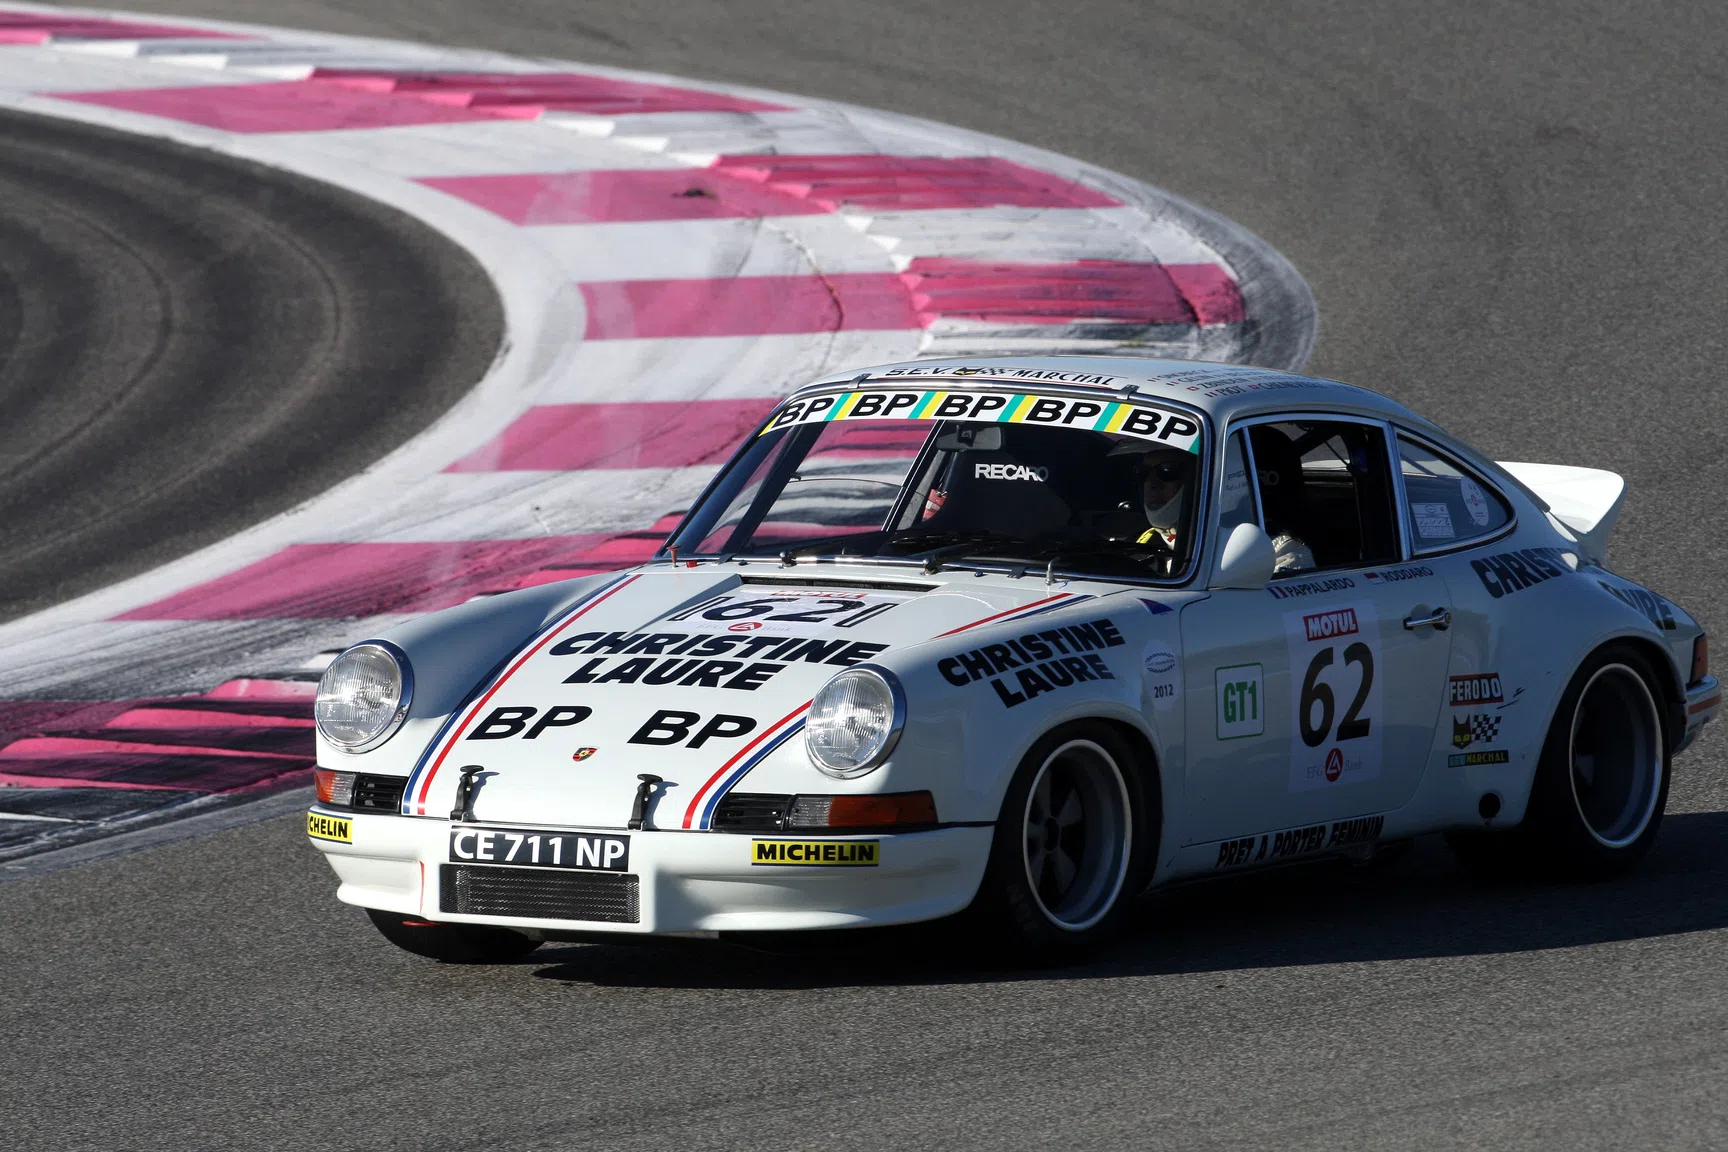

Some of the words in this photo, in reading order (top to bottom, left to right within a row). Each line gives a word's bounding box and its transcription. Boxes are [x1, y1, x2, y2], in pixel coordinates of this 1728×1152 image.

[1011, 369, 1115, 386] MARCHAL
[772, 397, 835, 428] BP
[848, 393, 919, 417] BP
[934, 394, 1007, 418] BP
[1025, 398, 1102, 425] BP
[1121, 408, 1198, 441] BP
[974, 463, 1049, 482] RECARO
[1284, 577, 1356, 597] PAPPALARDO
[702, 598, 866, 622] 62
[1306, 610, 1358, 639] MOTUL
[548, 631, 890, 667] CHRISTINE
[937, 618, 1126, 687] CHRISTINE
[561, 657, 788, 691] LAURE
[990, 653, 1116, 708] LAURE
[1153, 683, 1174, 698] 2012
[1450, 676, 1502, 702] FERODO
[1223, 680, 1258, 724] GT1
[1300, 642, 1374, 748] 62
[466, 705, 593, 740] BP
[627, 709, 757, 749] BP
[309, 816, 348, 838] CHELIN
[1215, 838, 1255, 868] PRET
[1255, 835, 1268, 862] A
[1270, 825, 1326, 859] PORTER
[1326, 816, 1385, 847] FEMININ
[453, 831, 495, 860] CE
[505, 834, 563, 864] 711
[576, 837, 625, 868] NP
[756, 842, 876, 862] MICHELIN
